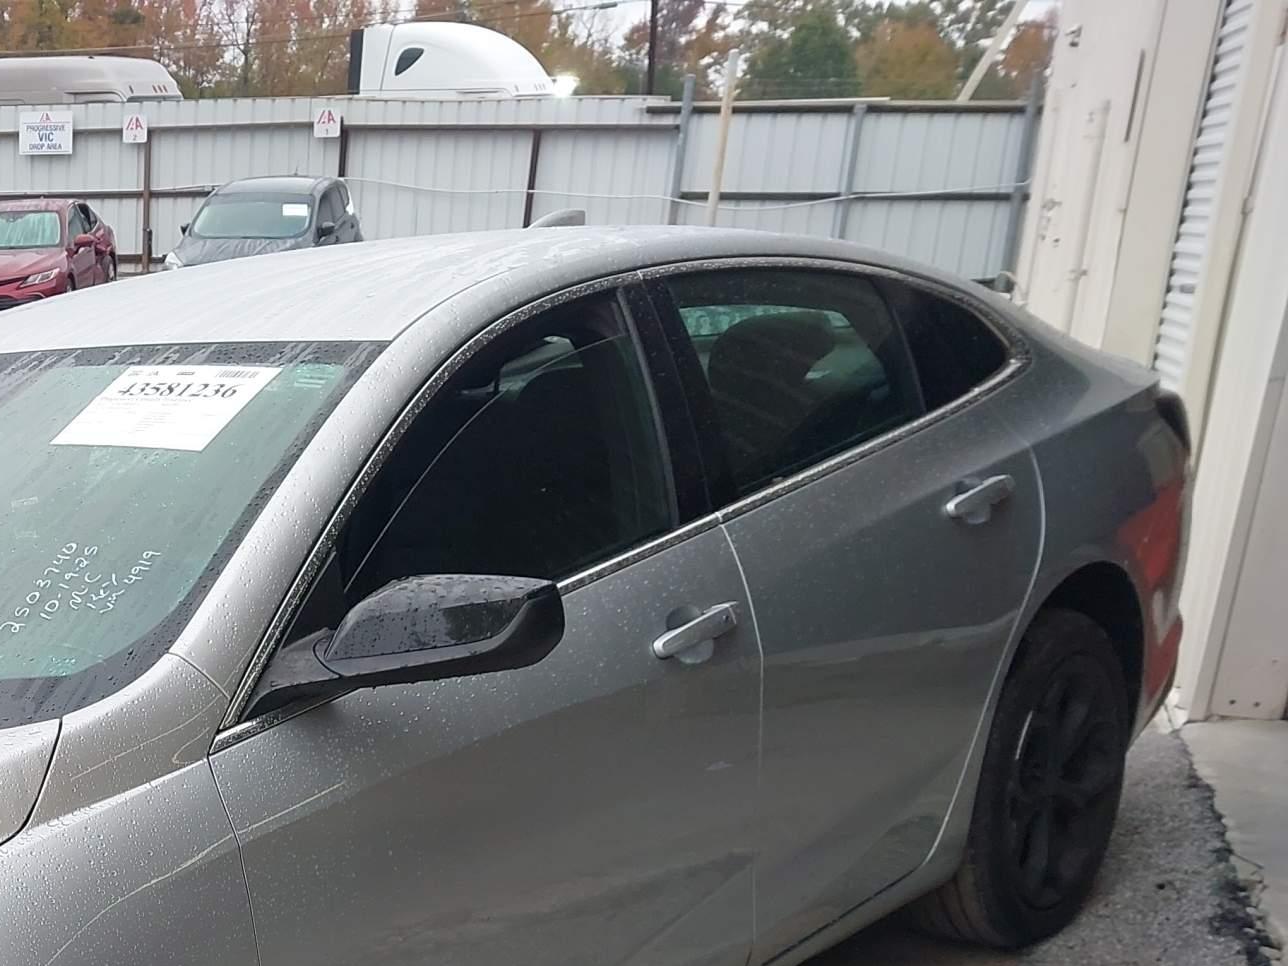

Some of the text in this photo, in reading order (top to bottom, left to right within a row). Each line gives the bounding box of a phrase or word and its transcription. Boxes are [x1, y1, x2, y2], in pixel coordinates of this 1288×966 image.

[38, 132, 54, 142] VIC
[118, 382, 239, 398] 43581236
[123, 550, 161, 584] 4919
